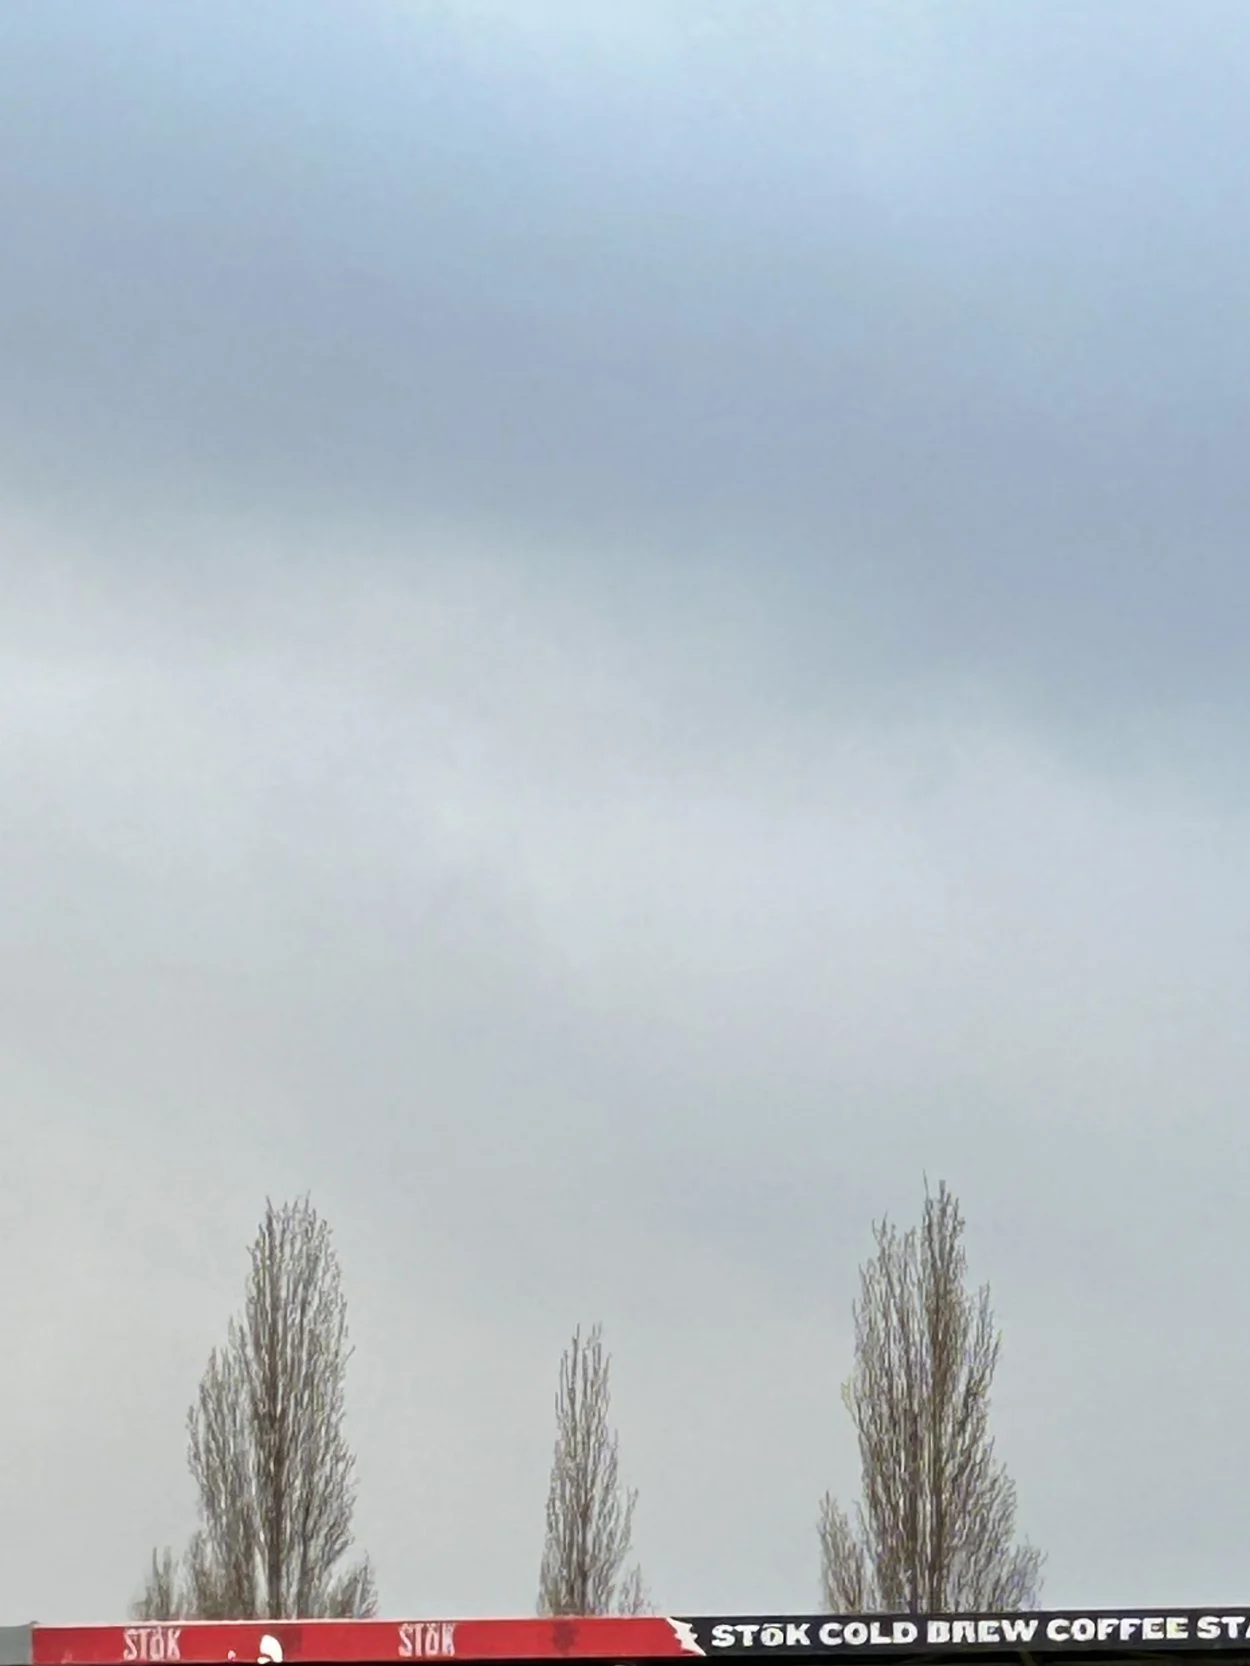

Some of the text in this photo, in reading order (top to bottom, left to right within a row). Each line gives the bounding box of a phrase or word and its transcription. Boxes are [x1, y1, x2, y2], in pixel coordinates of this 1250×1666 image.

[819, 1620, 918, 1645] COLD
[927, 1617, 1039, 1644] BREW
[1046, 1616, 1189, 1643] COFFEE
